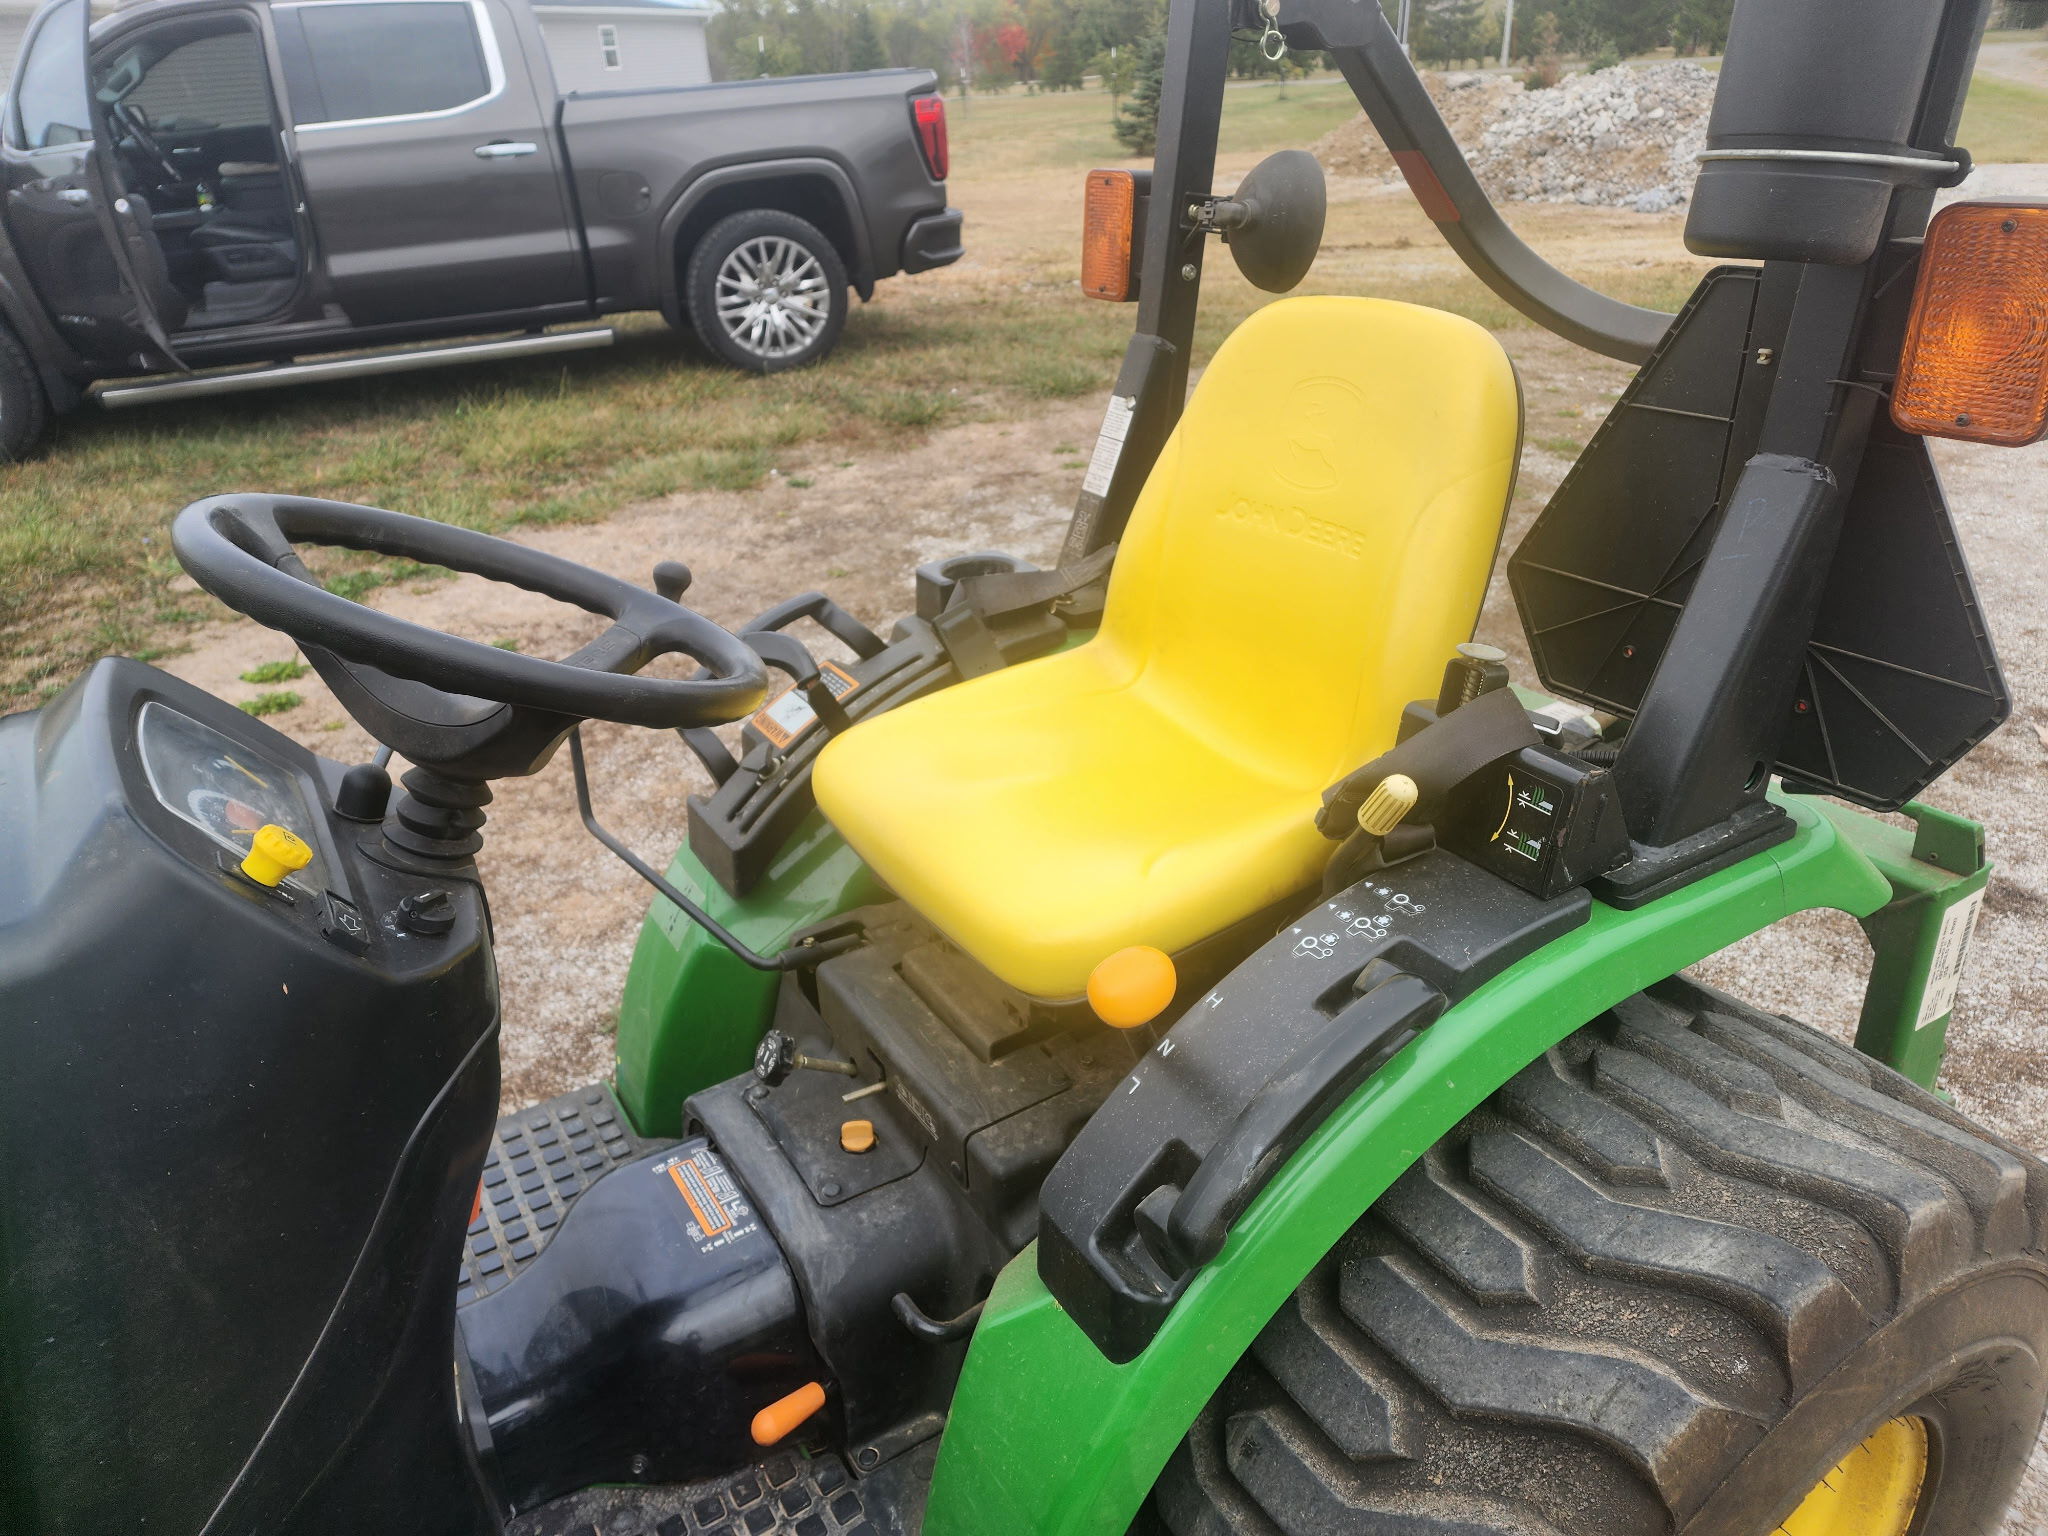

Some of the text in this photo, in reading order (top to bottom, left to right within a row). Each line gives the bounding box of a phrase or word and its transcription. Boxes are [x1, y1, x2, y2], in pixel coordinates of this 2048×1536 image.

[1216, 494, 1366, 560] JOHN DEERE
[1207, 993, 1223, 1008] H
[1158, 1039, 1175, 1057] N
[1128, 1076, 1141, 1095] L
